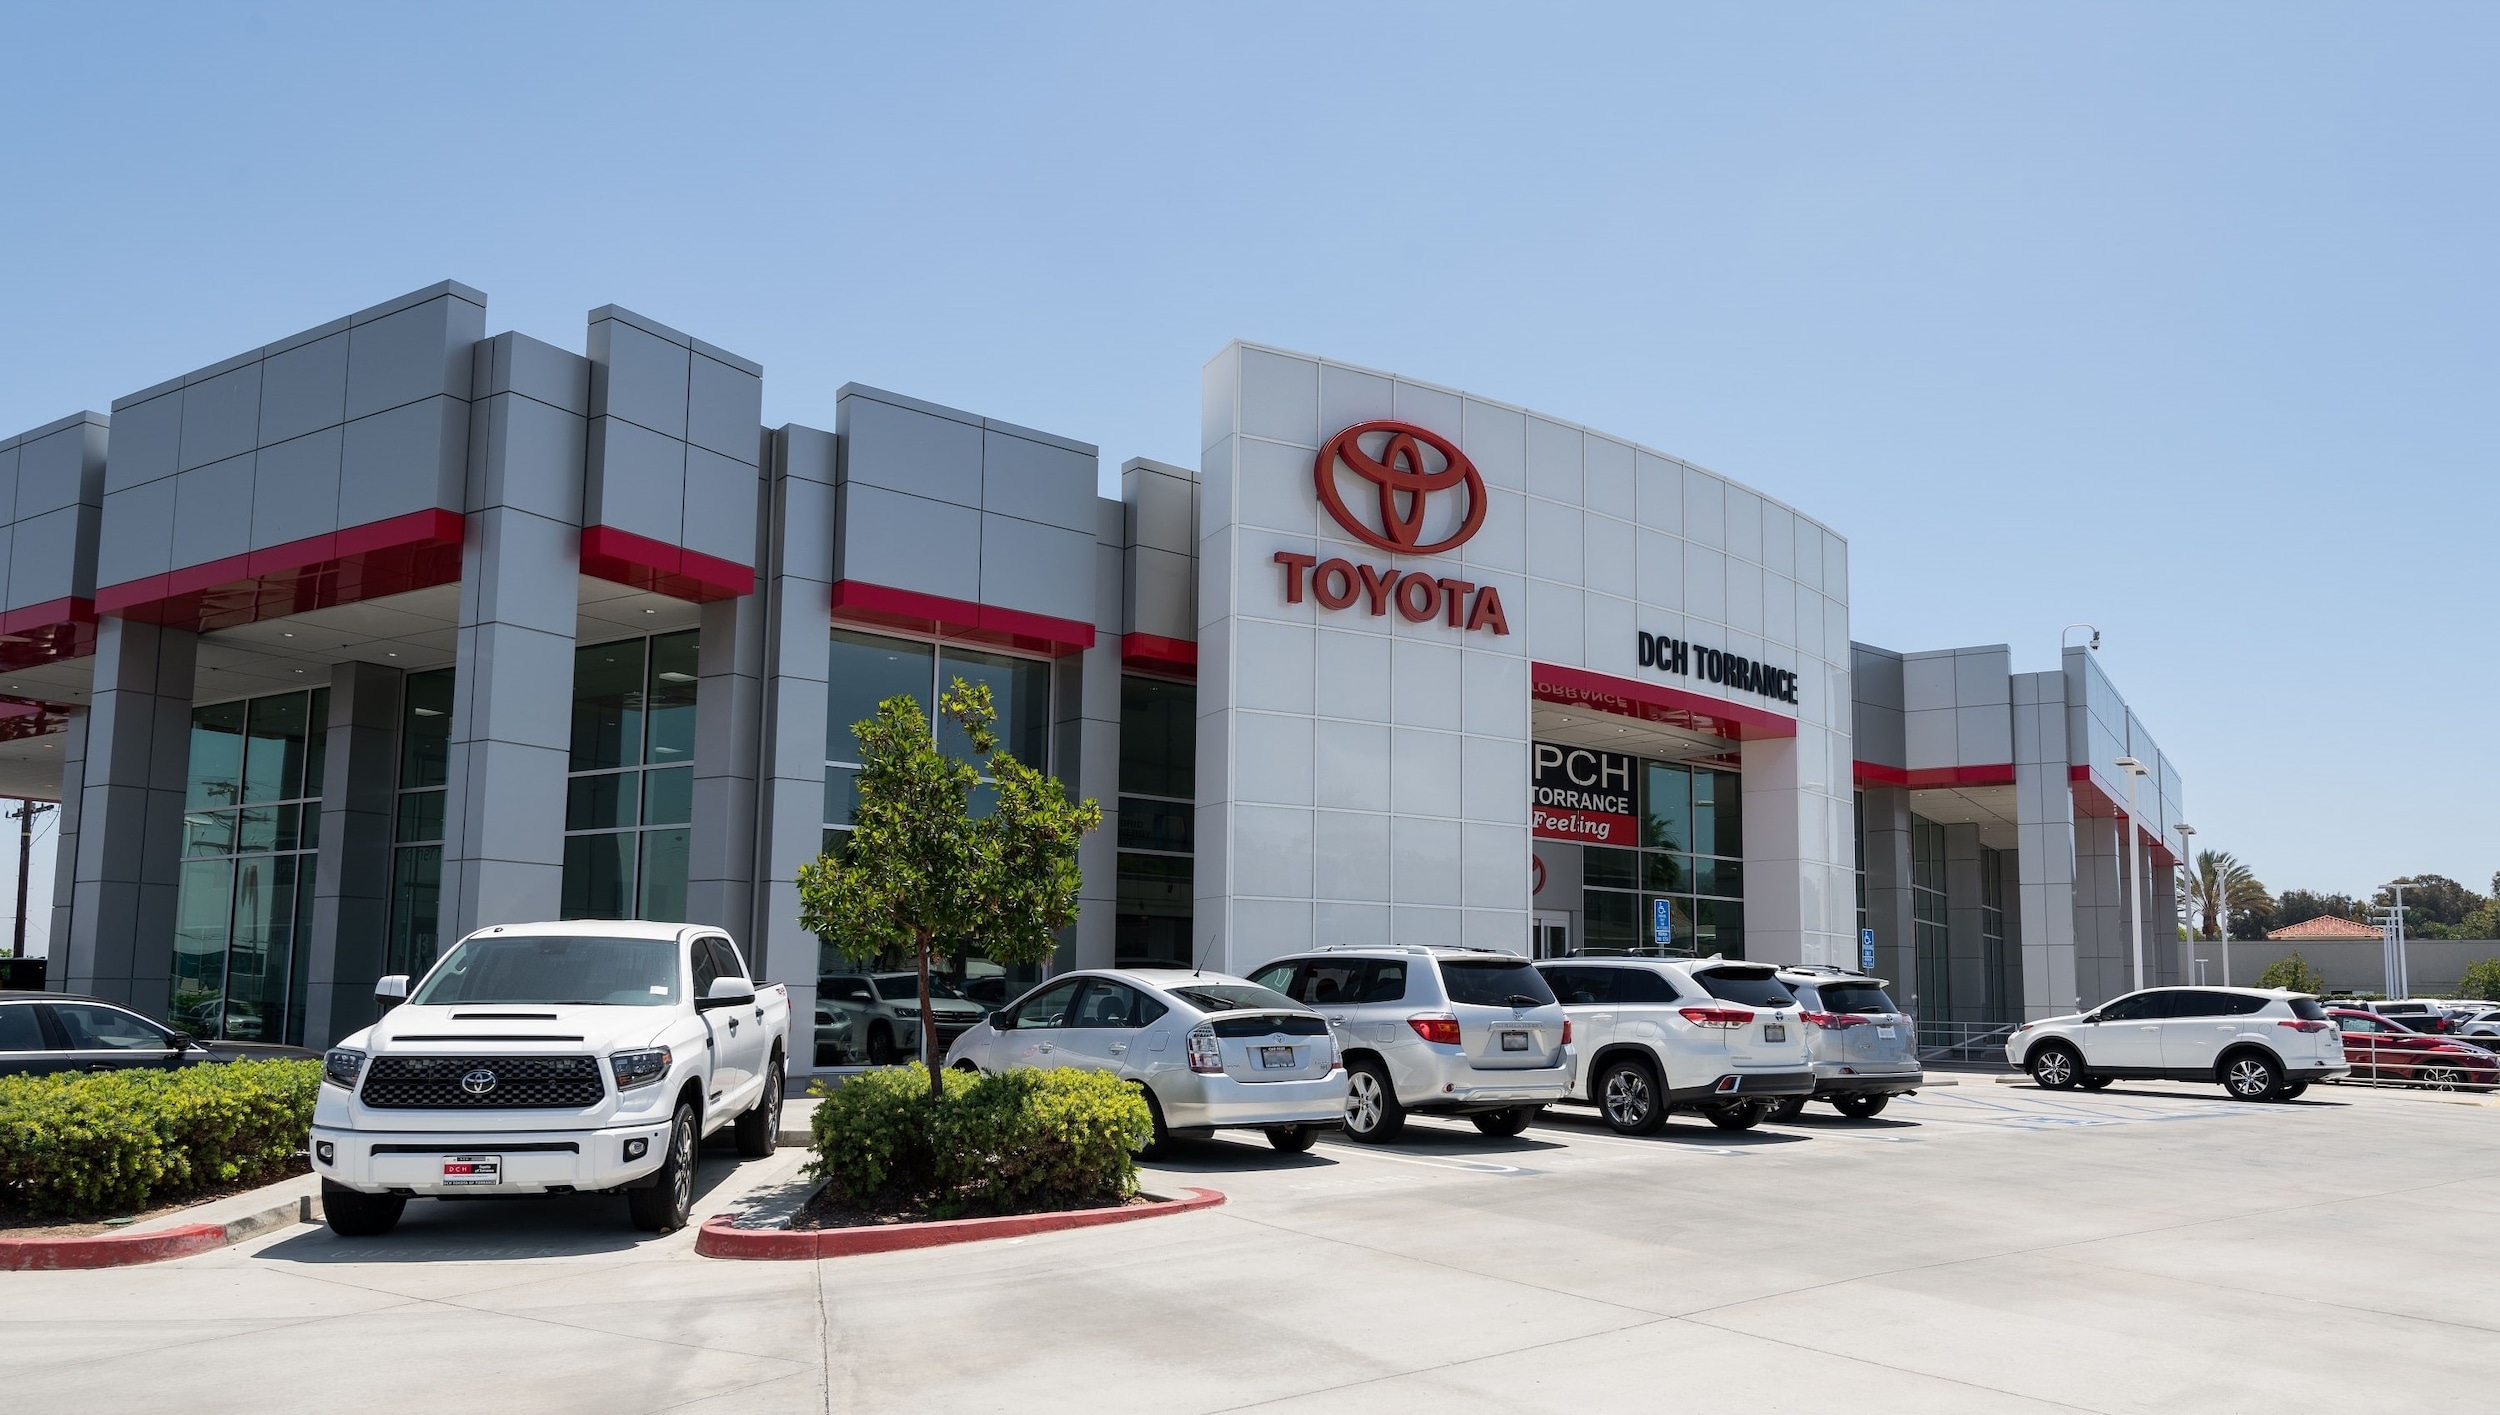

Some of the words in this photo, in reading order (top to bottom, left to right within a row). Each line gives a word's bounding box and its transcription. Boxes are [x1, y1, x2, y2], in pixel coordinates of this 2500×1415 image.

[1274, 551, 1510, 635] TOYOTA
[1638, 631, 1688, 675] DCH
[1693, 645, 1798, 705] TORRANCE
[1535, 744, 1629, 791] PCH
[1532, 786, 1629, 815] TORRANCE
[1532, 811, 1610, 840] Feeling
